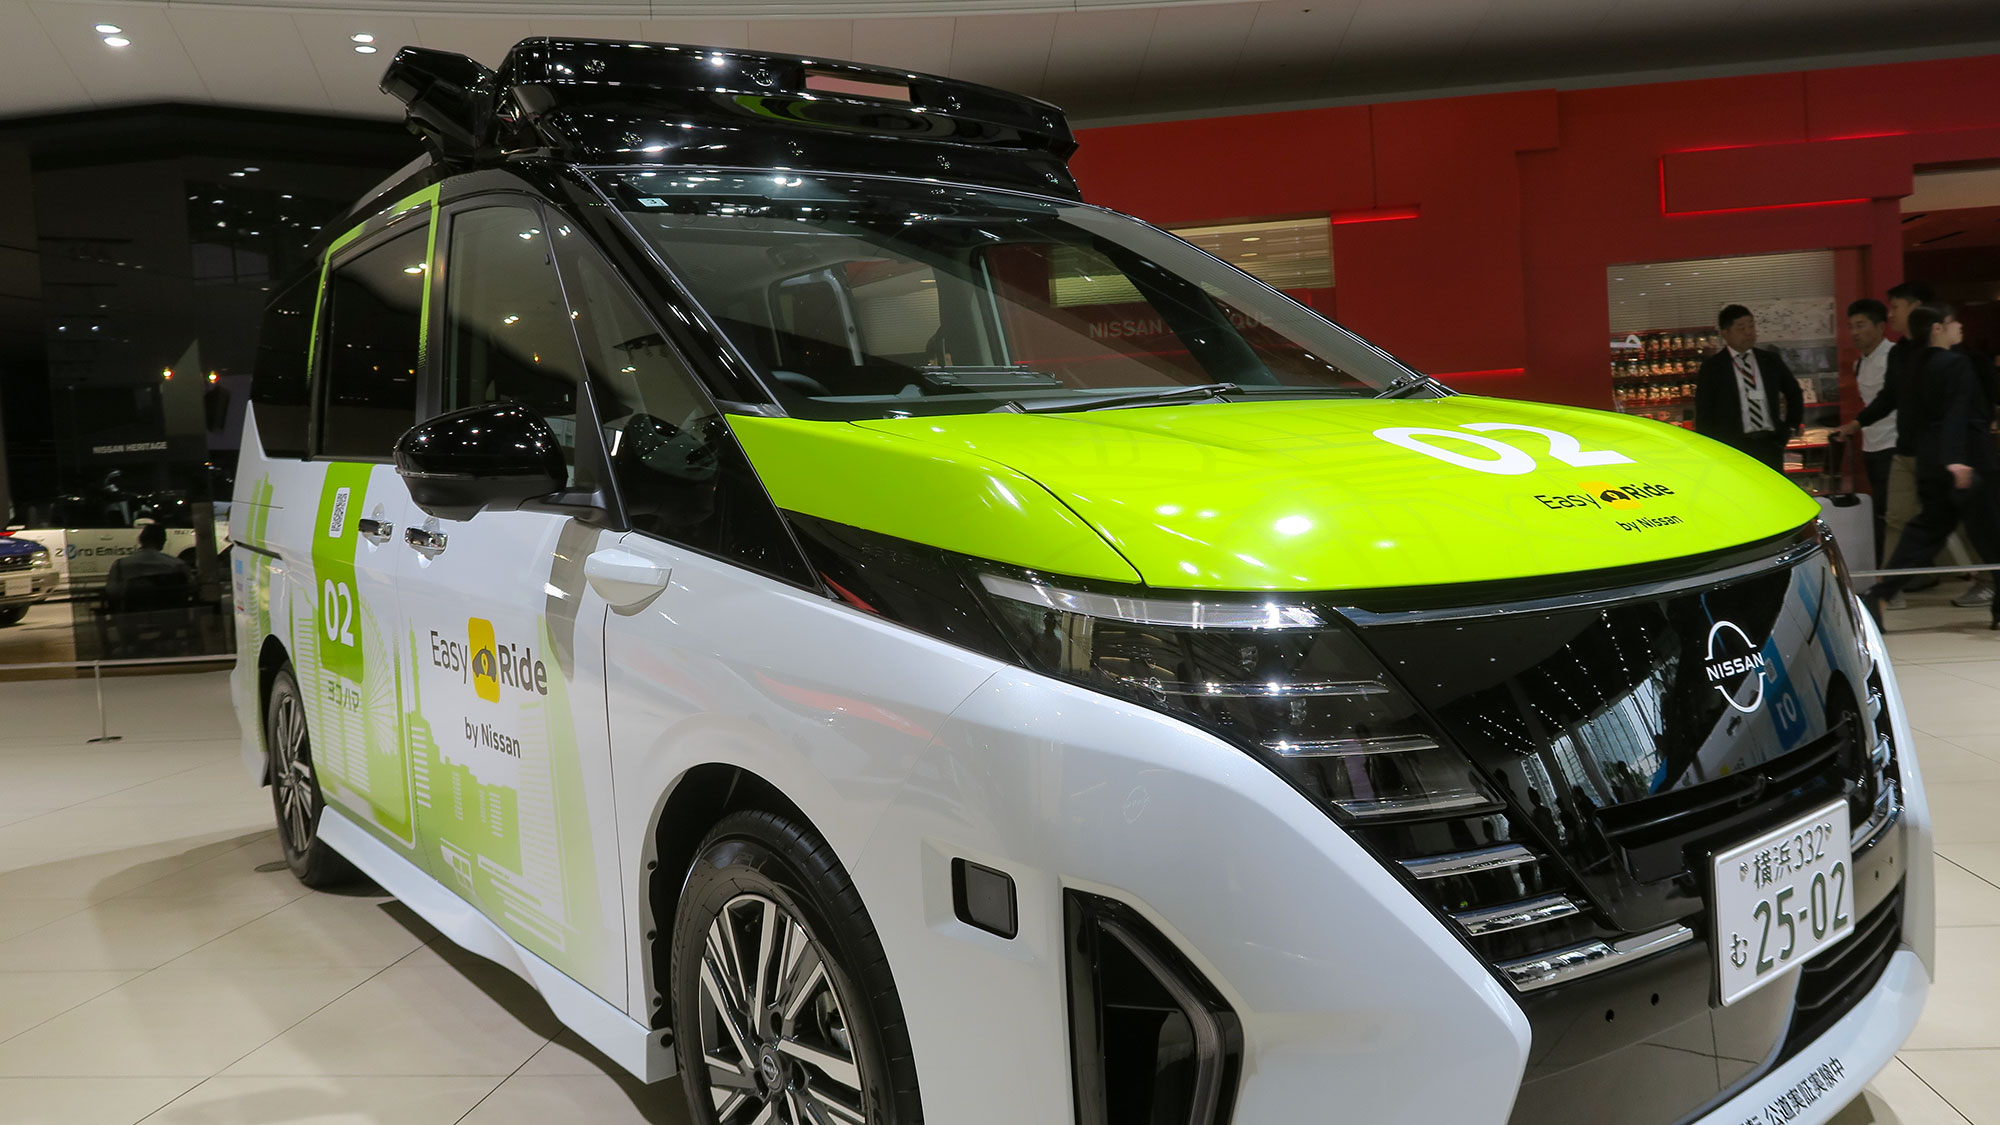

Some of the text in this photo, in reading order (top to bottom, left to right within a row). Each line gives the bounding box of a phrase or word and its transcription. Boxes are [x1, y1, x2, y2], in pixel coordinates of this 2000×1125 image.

[1089, 320, 1162, 338] NISSAN
[1372, 422, 1638, 475] 02
[1534, 482, 1675, 509] Easy Ride
[1616, 513, 1683, 533] by Nissan
[323, 579, 354, 647] 02
[431, 631, 547, 696] Easy Ride
[1705, 652, 1765, 682] NISSAN
[465, 717, 521, 759] by Nissan
[1731, 861, 1848, 976] む 25-02
